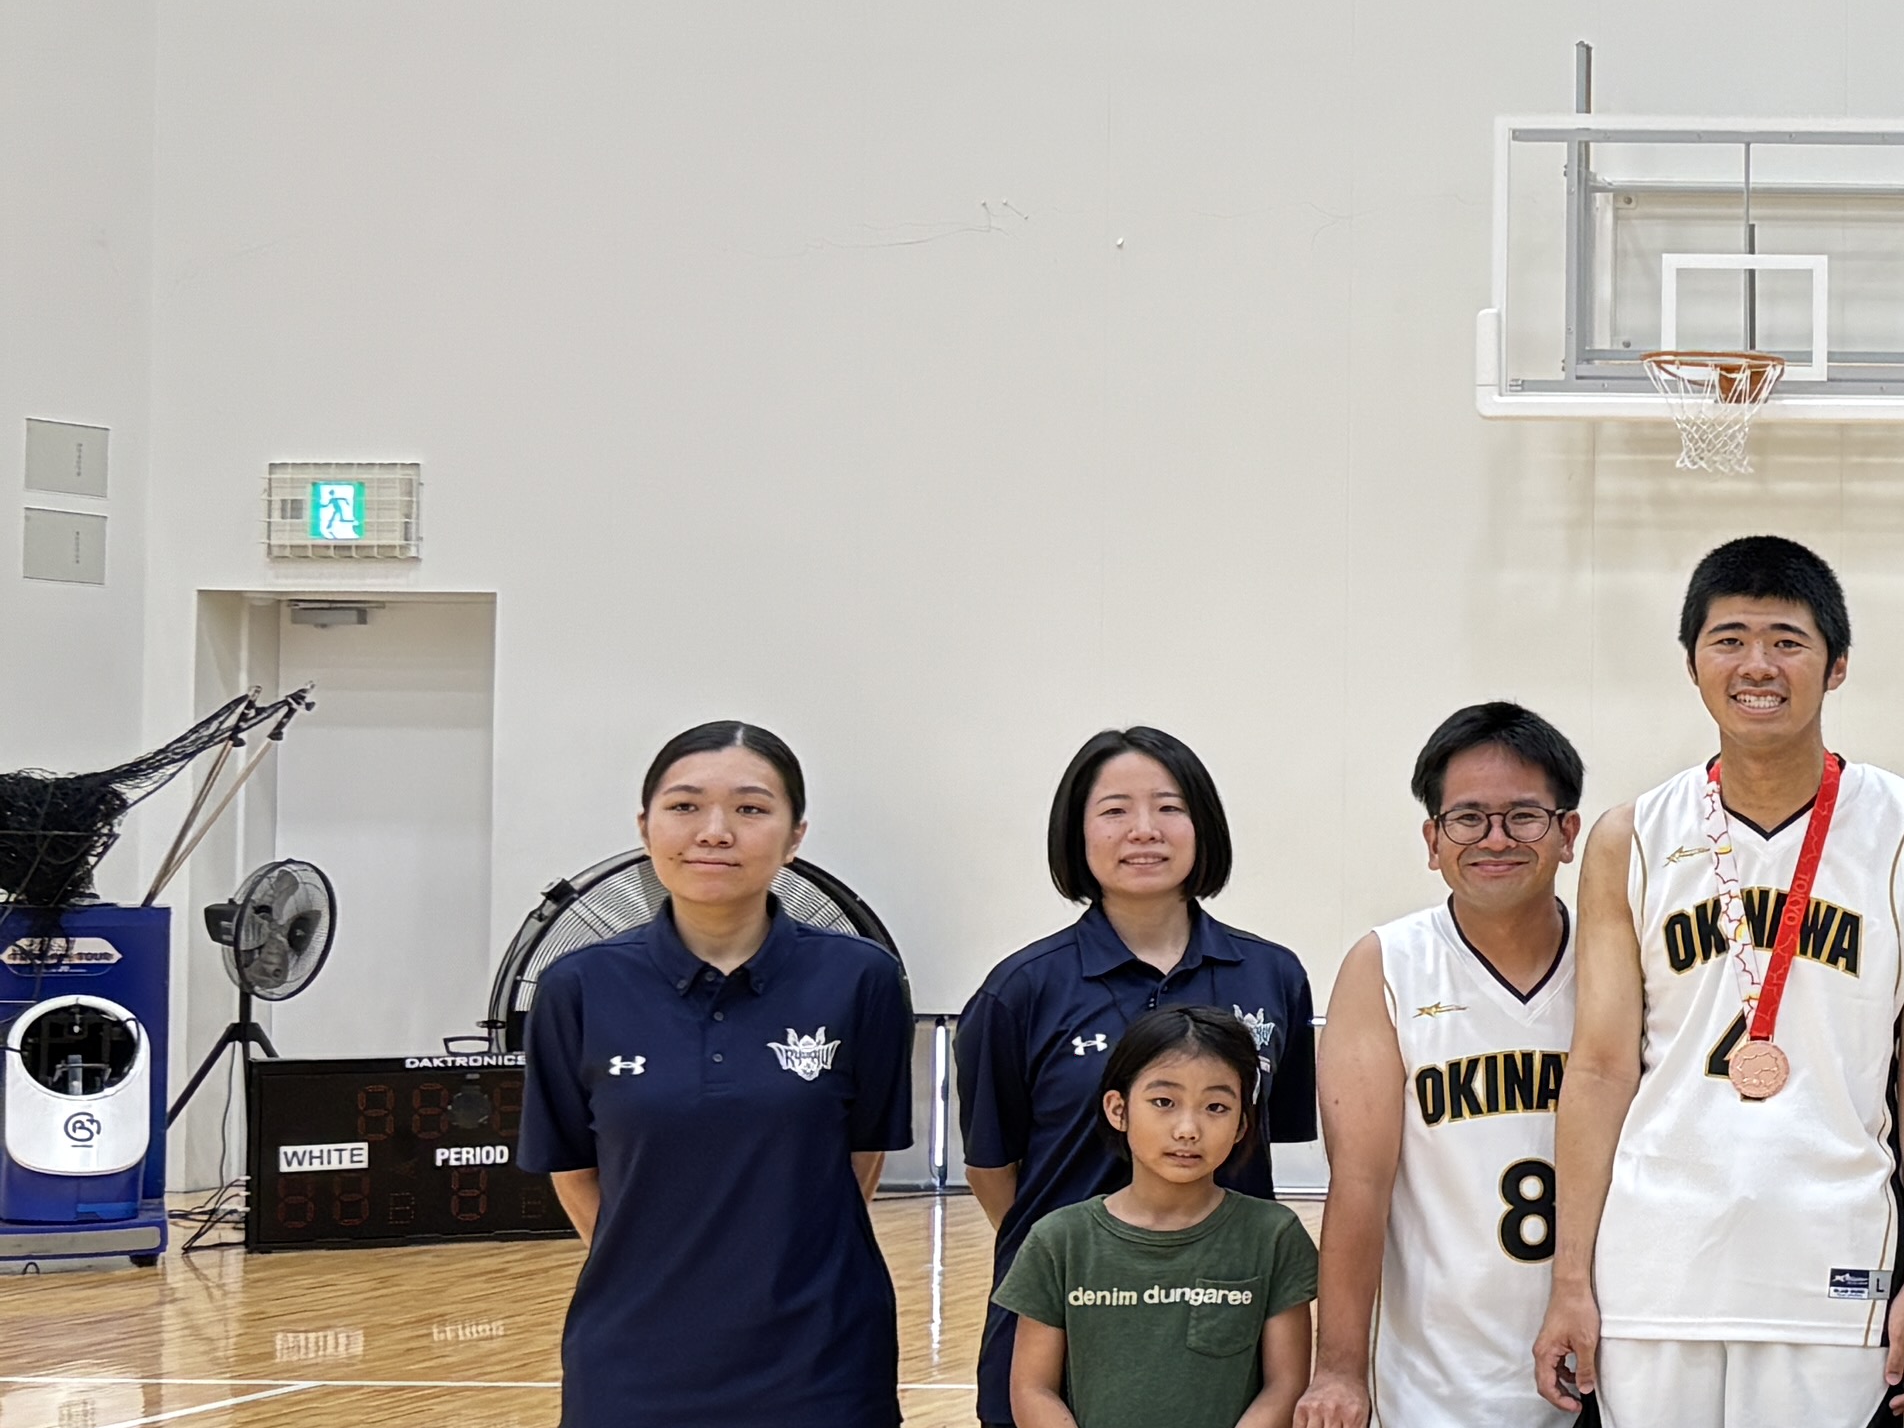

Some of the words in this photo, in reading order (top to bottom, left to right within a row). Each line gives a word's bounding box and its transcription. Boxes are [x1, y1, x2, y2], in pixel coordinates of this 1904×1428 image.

[1786, 873, 1811, 927] TOKYO
[1662, 885, 1864, 979] OKNWA
[404, 1054, 527, 1069] DAKTRONICS
[1415, 1049, 1570, 1128] OKINA
[283, 1146, 365, 1168] WHITE
[435, 1145, 510, 1167] PERIOD
[1497, 1157, 1557, 1264] 8
[1067, 1287, 1138, 1307] denim
[1142, 1284, 1253, 1307] dungaree
[1875, 1277, 1885, 1293] L
